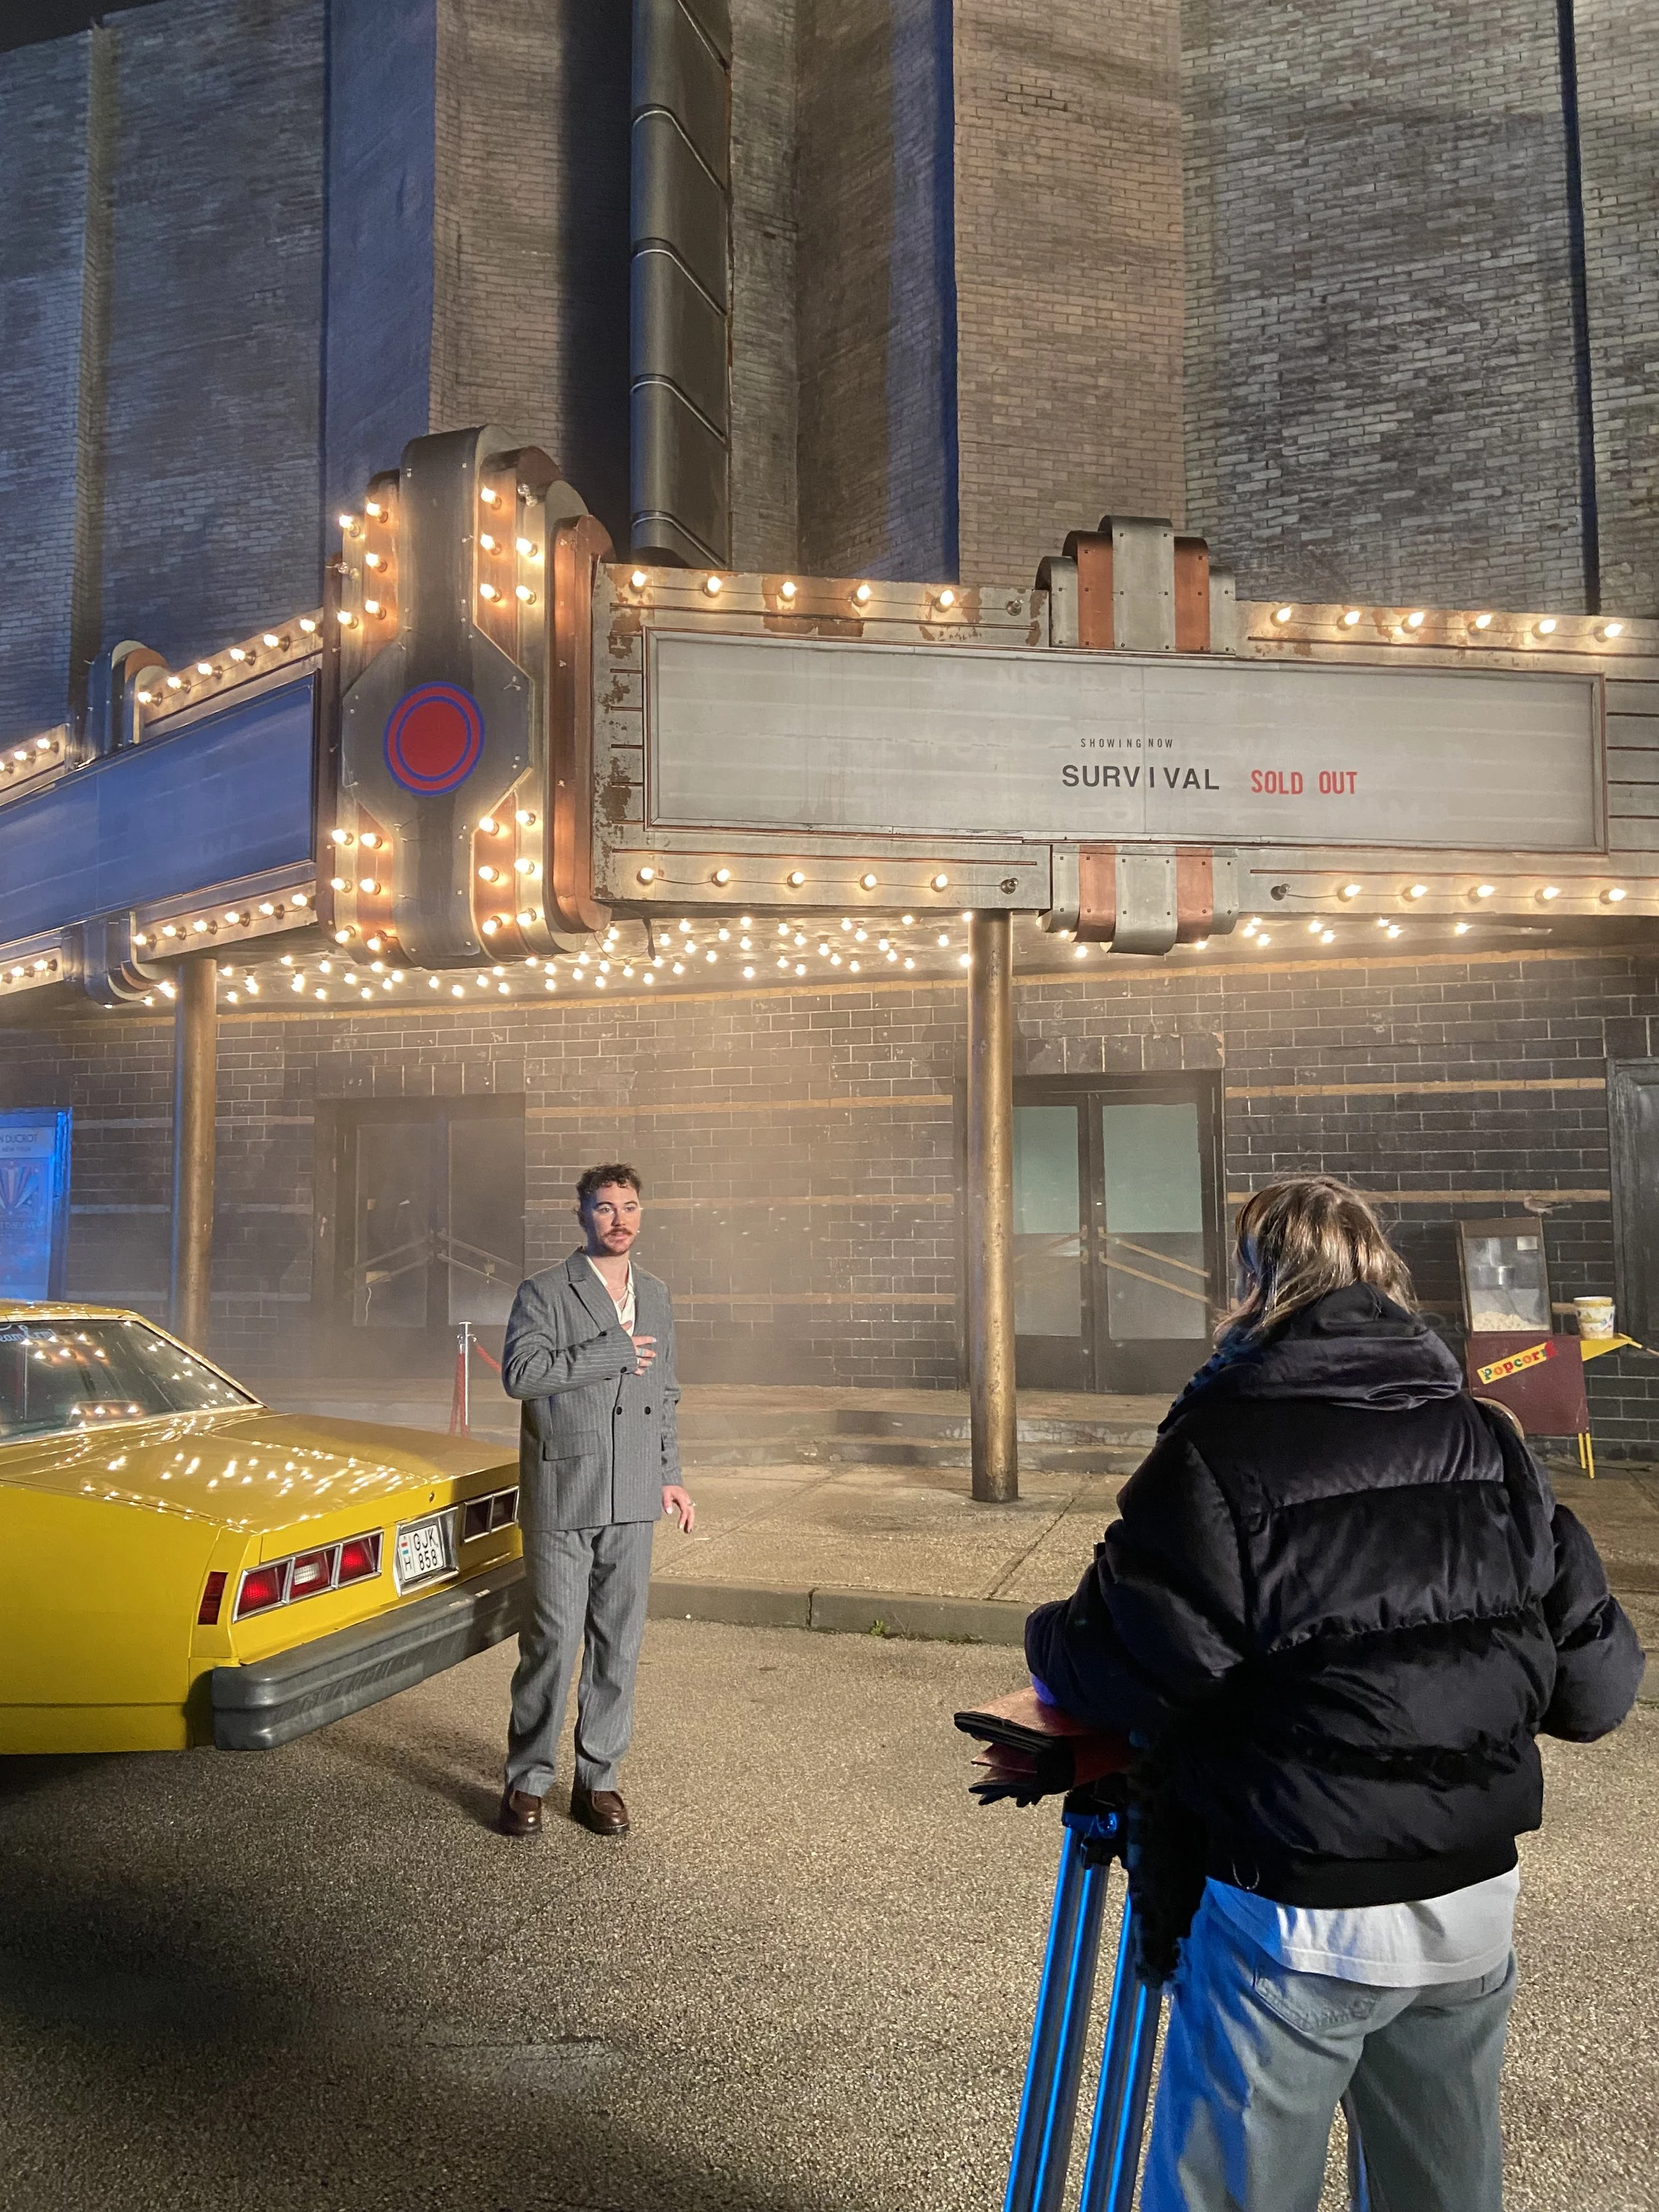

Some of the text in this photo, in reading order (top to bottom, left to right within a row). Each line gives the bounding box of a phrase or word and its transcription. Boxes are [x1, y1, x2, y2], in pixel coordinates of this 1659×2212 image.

[1080, 738, 1173, 749] SHOWING NOW
[1062, 764, 1220, 790] SURVIVAL
[1250, 769, 1358, 795] SOLD OUT
[413, 1527, 437, 1551] GJK
[403, 1556, 412, 1572] H
[418, 1548, 437, 1571] 858
